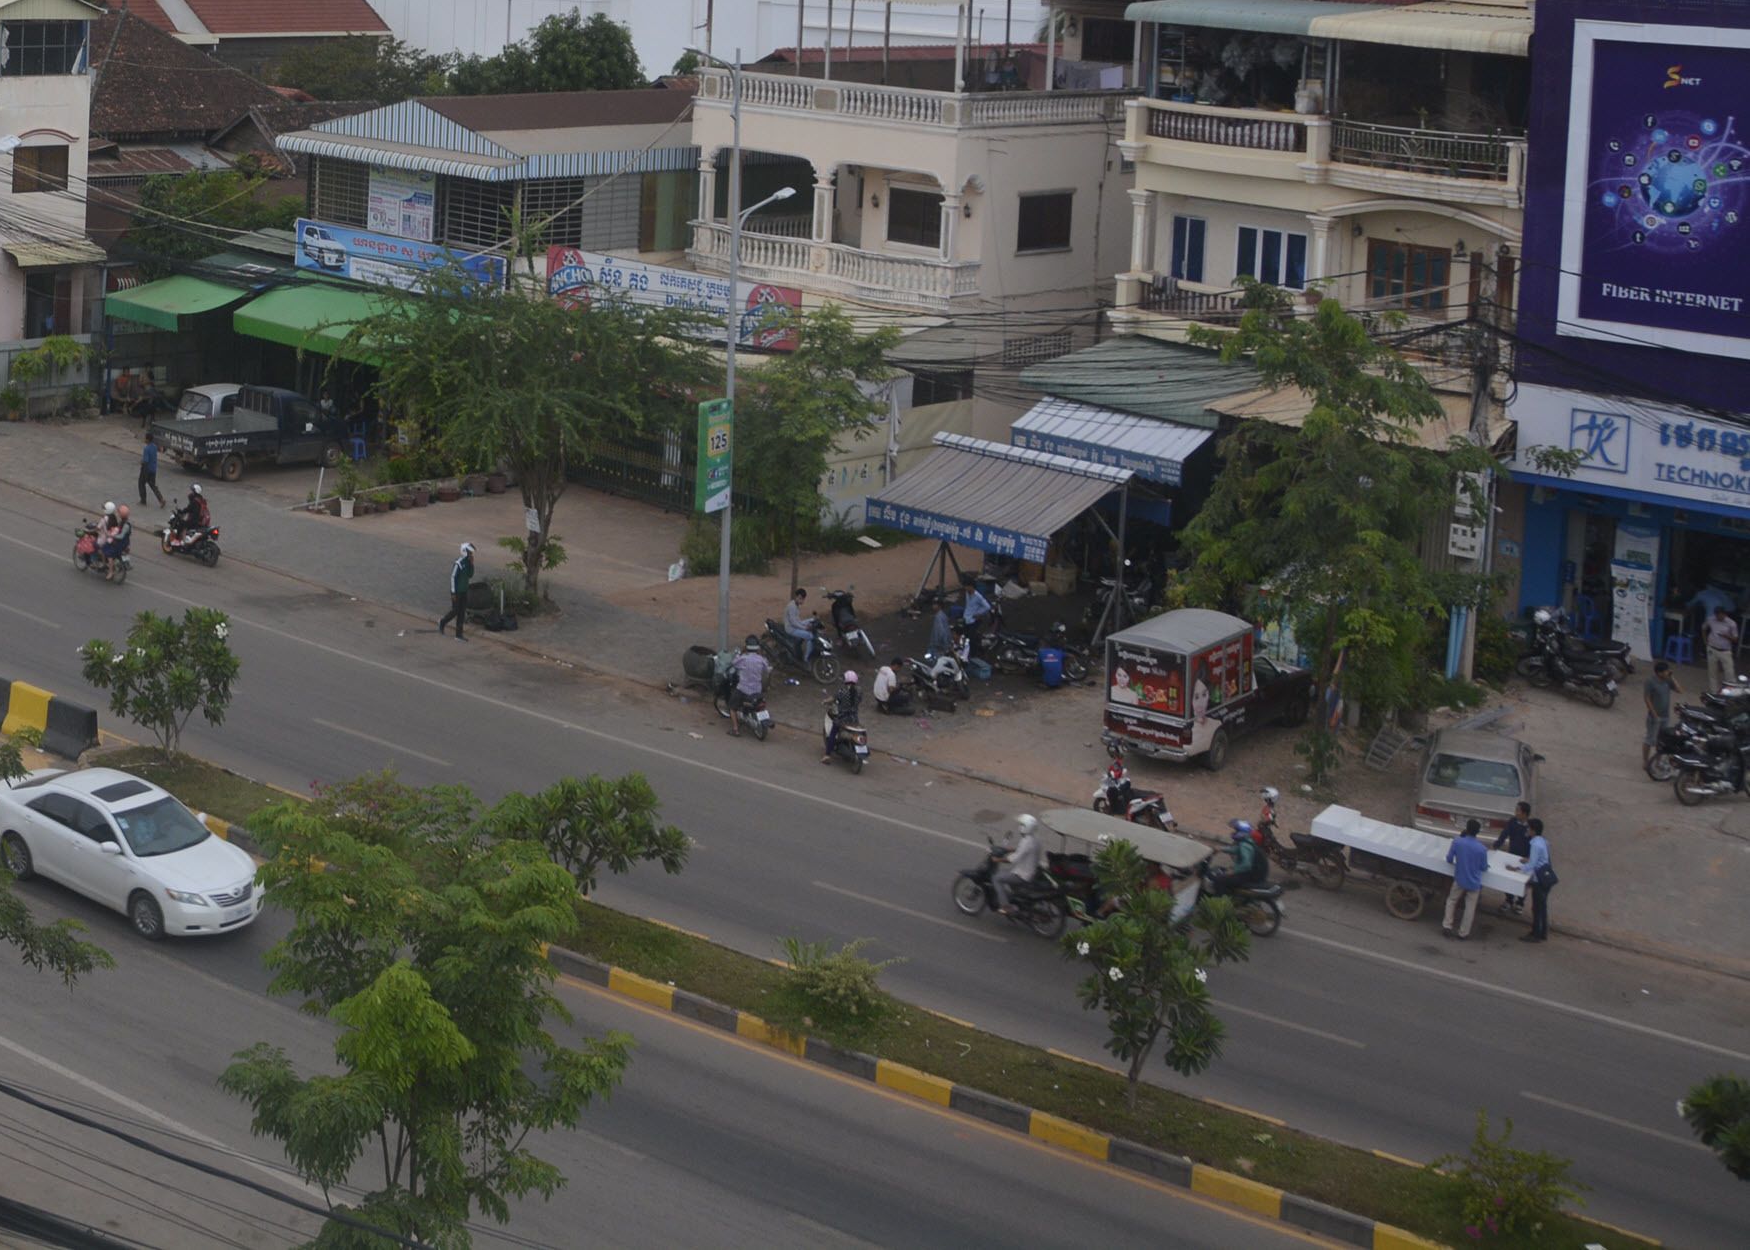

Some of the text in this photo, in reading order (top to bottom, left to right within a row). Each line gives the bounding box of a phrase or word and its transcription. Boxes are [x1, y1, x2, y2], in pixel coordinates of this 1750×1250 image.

[666, 294, 695, 311] Drink
[1601, 283, 1744, 312] FIBER INTERNET
[710, 433, 727, 451] 125
